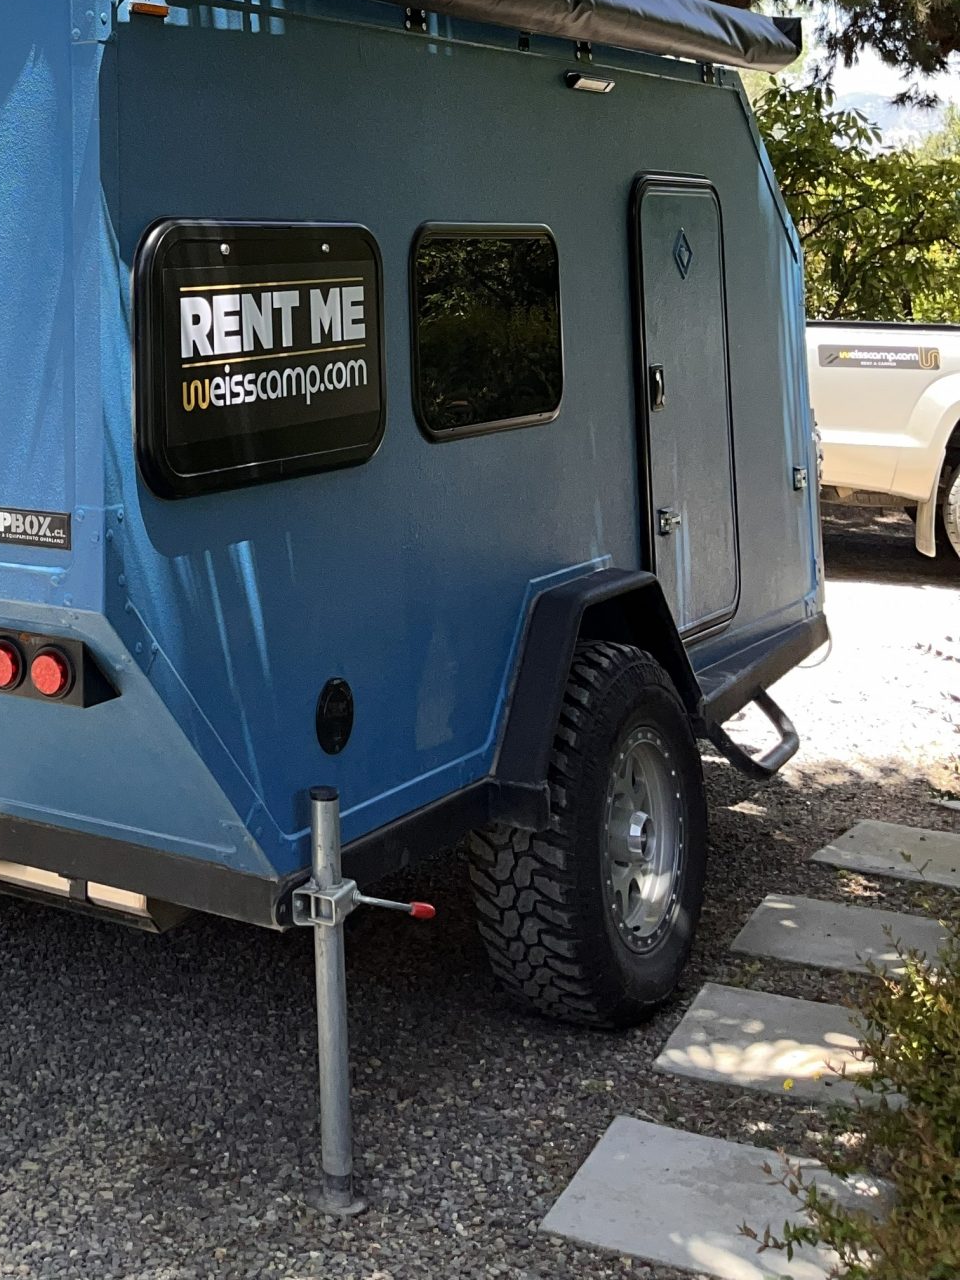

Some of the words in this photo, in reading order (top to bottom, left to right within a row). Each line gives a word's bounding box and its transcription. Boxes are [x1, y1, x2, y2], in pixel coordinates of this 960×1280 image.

[180, 290, 300, 358] RENT
[309, 286, 366, 344] ME
[839, 350, 919, 362] weisscamp.com
[182, 358, 367, 412] weisscamp.com
